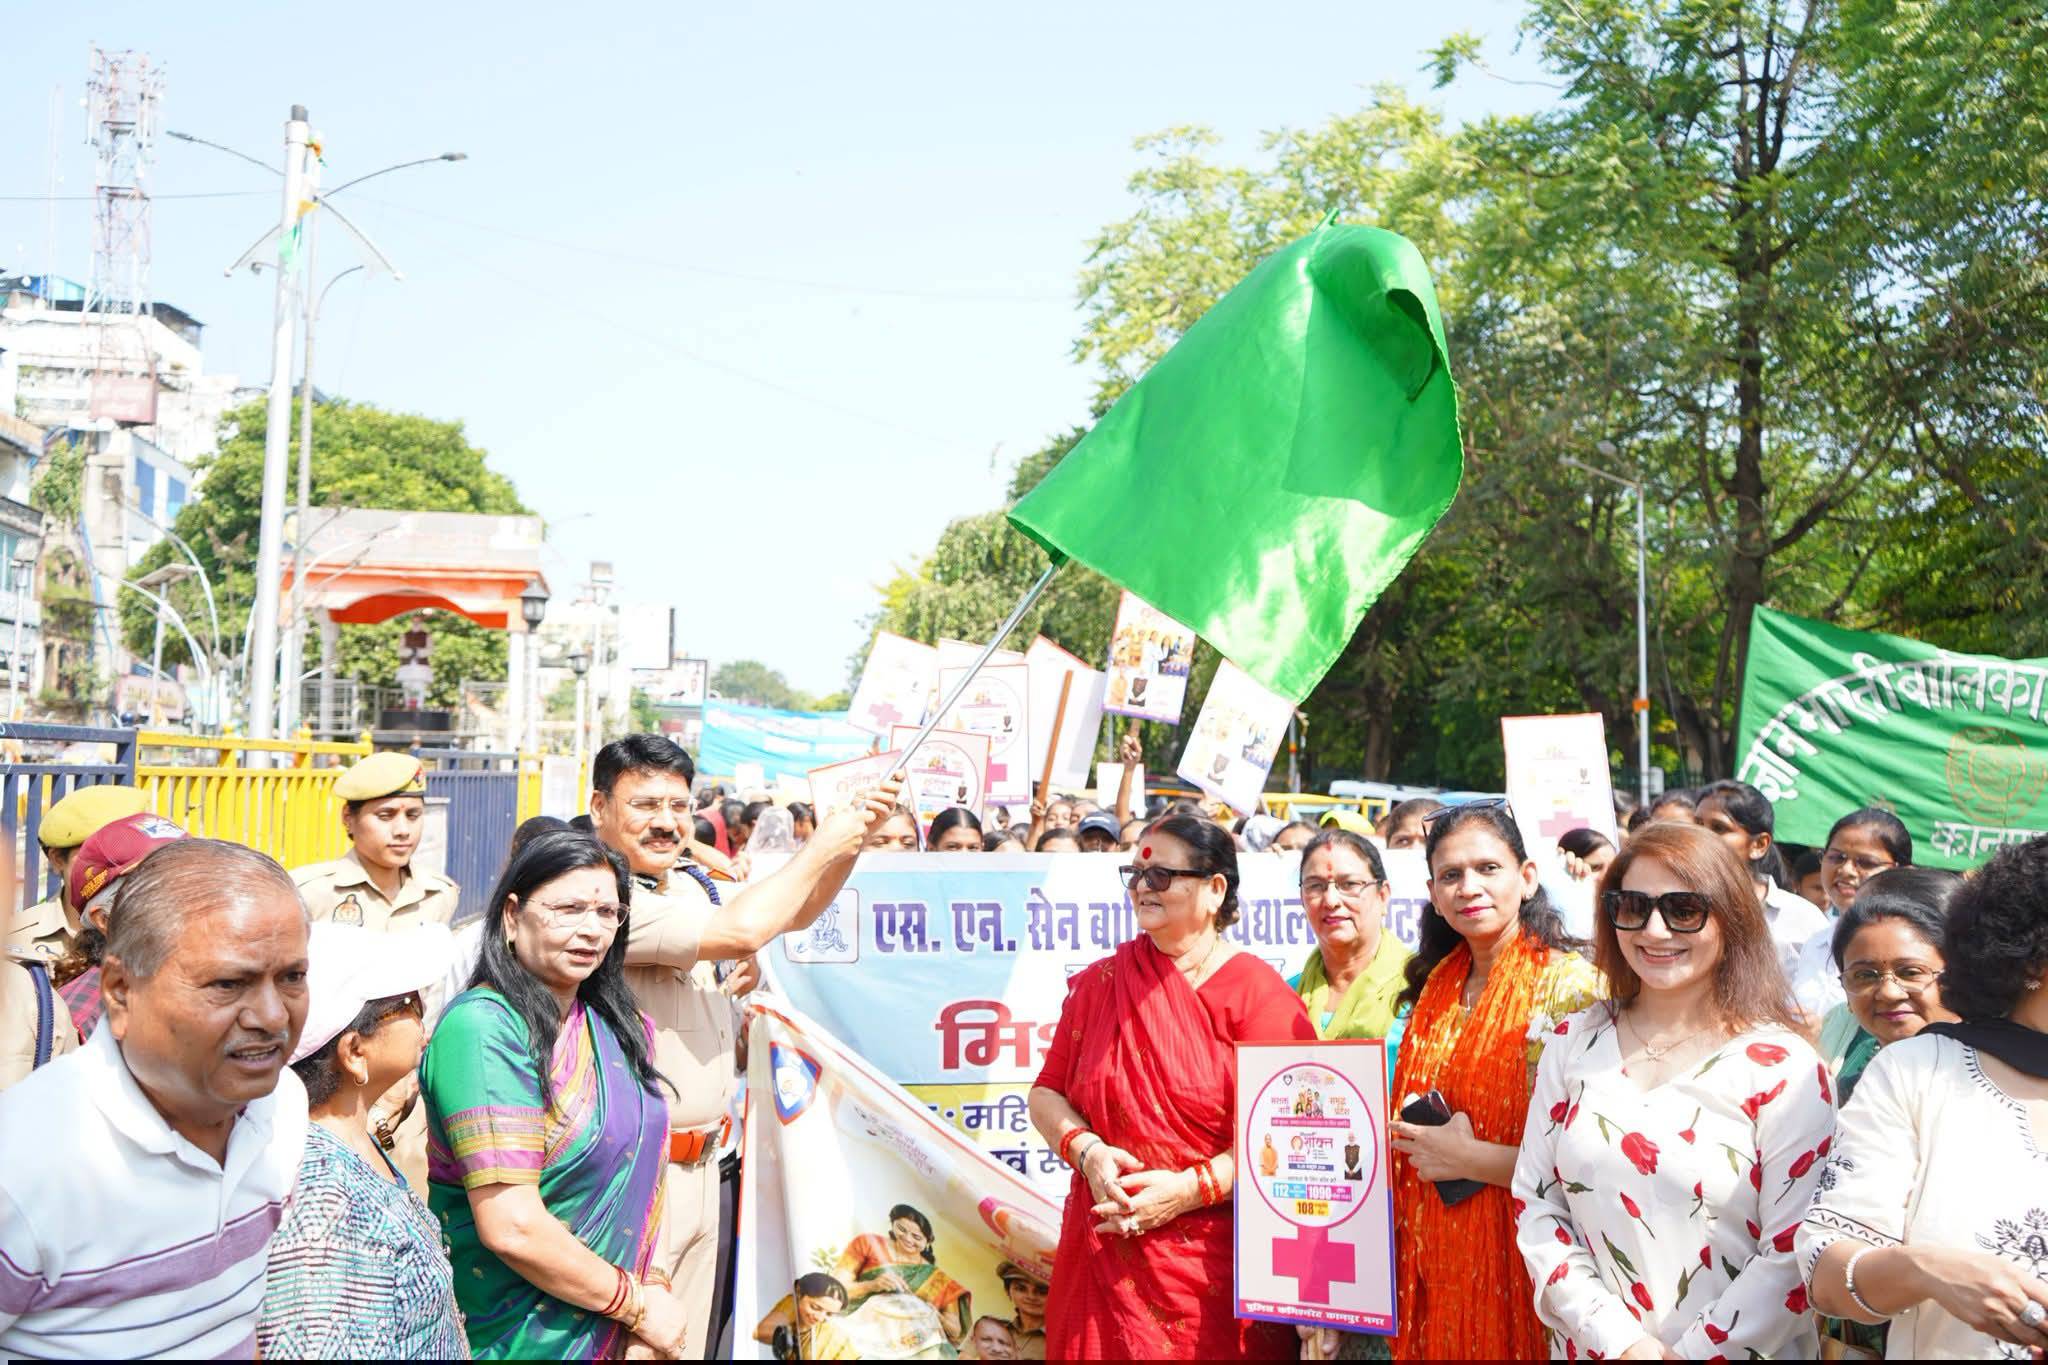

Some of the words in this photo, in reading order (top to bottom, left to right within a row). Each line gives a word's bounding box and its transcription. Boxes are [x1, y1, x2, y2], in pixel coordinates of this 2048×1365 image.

[872, 902, 941, 952] एस.
[951, 902, 1017, 951] एन.
[1025, 887, 1080, 951] सेन
[963, 1094, 1029, 1133] महि
[1274, 1183, 1289, 1197] 112
[1308, 1185, 1332, 1200] 1090
[1297, 1201, 1314, 1215] 108
